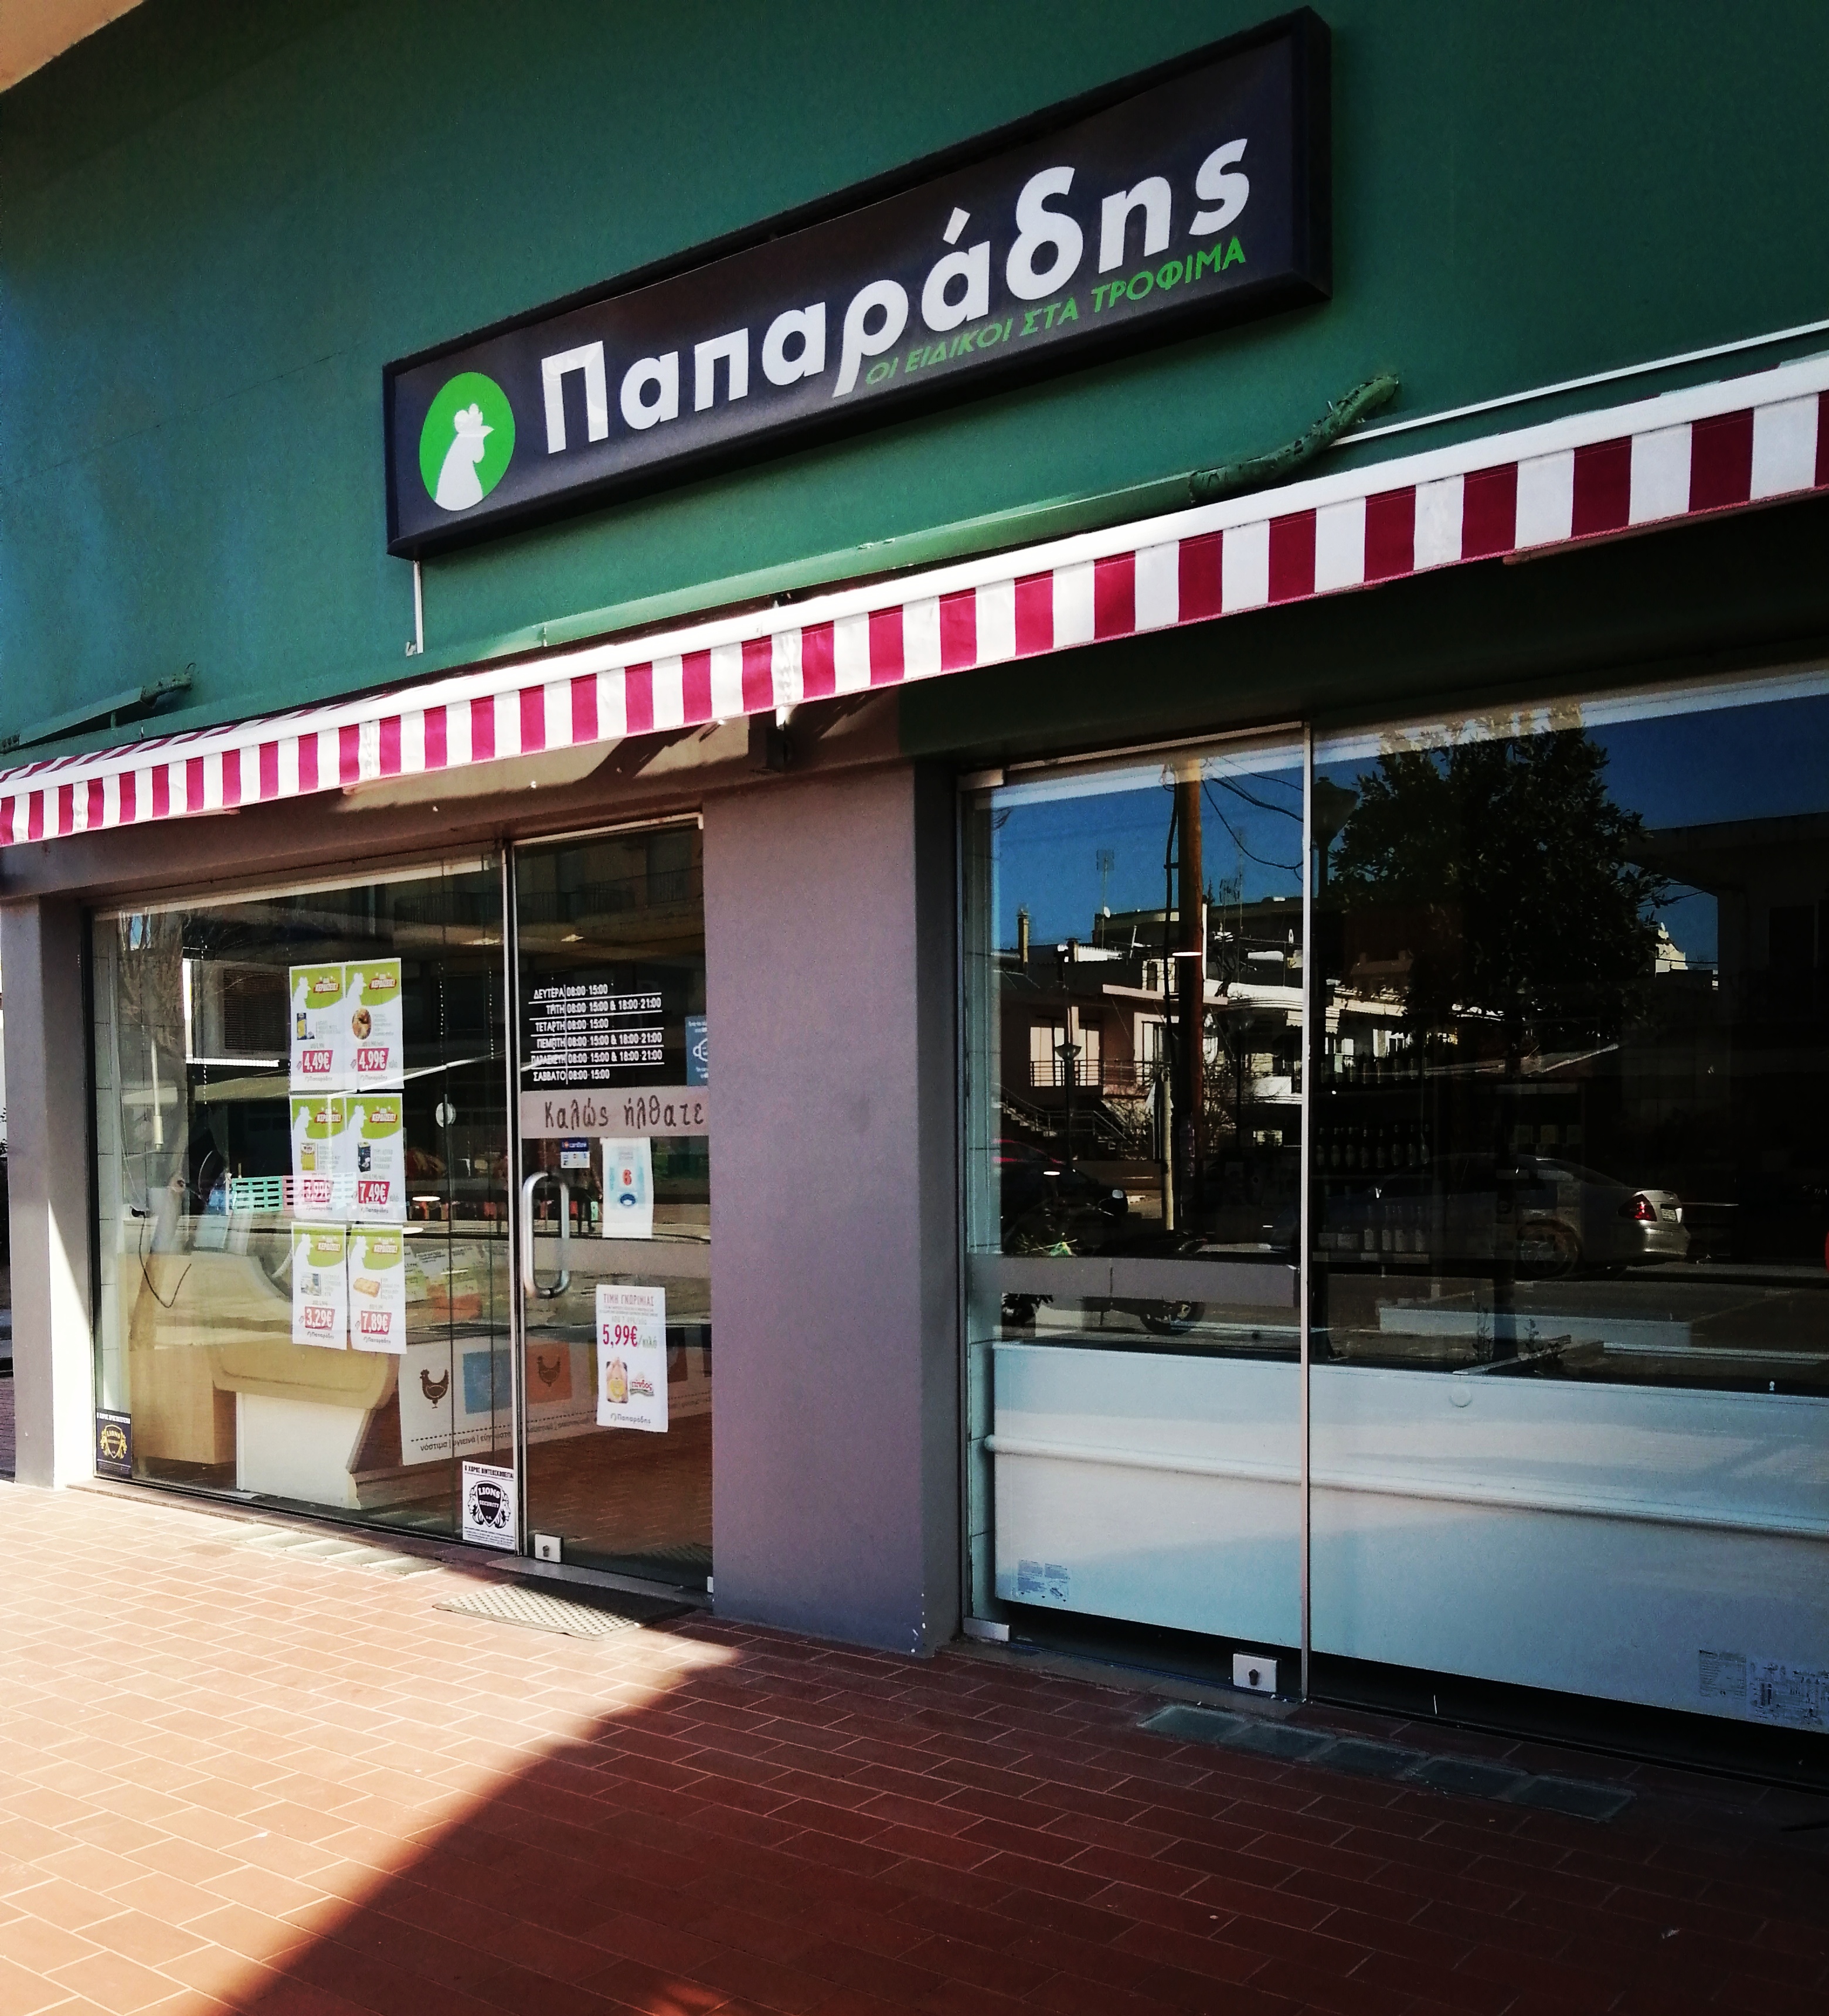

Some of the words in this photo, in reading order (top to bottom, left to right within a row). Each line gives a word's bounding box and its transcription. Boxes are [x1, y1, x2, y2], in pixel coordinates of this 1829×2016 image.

[540, 138, 1251, 454] Παπαράδης
[865, 361, 898, 386] ΟΙ
[905, 318, 1013, 372] ΕΙΔΙΚΟΙ
[1019, 297, 1079, 337] ΣΤΑ
[1091, 236, 1246, 313] ΤΡΟΦΙΜΑ
[533, 987, 565, 999] ΔΕΥΤΕΡΑ
[546, 1004, 565, 1015] ΤΡΙΤΗ
[610, 1000, 616, 1011] &
[535, 1021, 566, 1032] ΤΕΤΑΡΤΗ
[536, 1037, 566, 1049] ΠΕΜΠΤΗ
[611, 1034, 617, 1045] &
[304, 1052, 330, 1072] 4,49€
[359, 1050, 385, 1070] 4,99€
[611, 1051, 617, 1062] &
[533, 1070, 566, 1082] ΣΑΒΒΑΤΟ
[545, 1097, 608, 1130] Καλώς
[624, 1095, 704, 1130] ήλθατε
[359, 1183, 386, 1202] 7,49€
[604, 1294, 618, 1304] ΤΙΜΗ
[621, 1294, 654, 1307] ΓΝΩΡΙΜΙΑΣ
[307, 1308, 333, 1328] 3,29€
[362, 1313, 389, 1333] 7,89€
[420, 1442, 447, 1451] νόστιμα
[478, 1487, 501, 1499] LIONS
[478, 1500, 499, 1508] SECURITY
